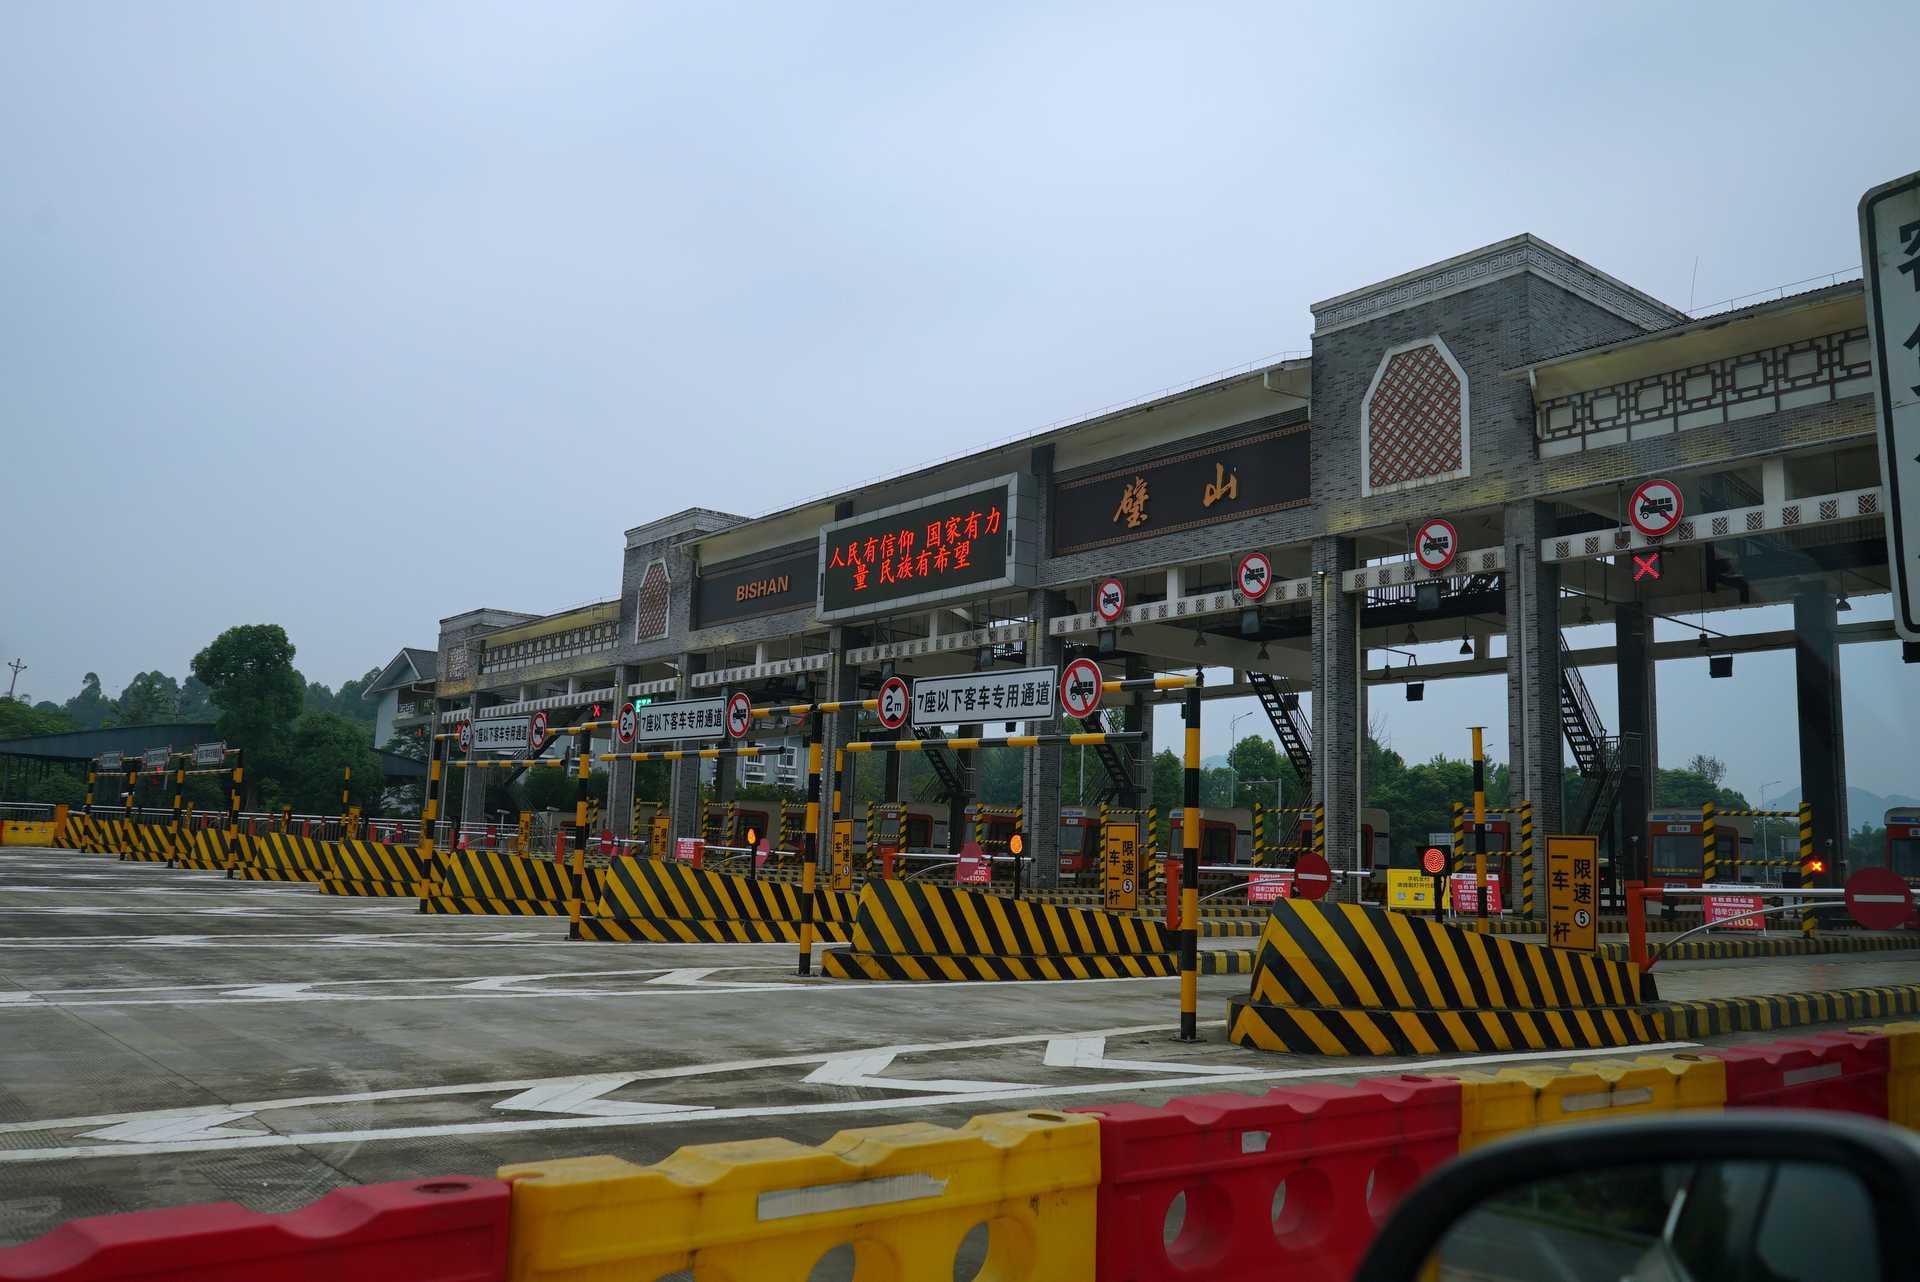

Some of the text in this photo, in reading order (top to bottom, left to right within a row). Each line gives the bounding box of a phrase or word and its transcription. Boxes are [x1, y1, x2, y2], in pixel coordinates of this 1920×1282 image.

[829, 506, 1001, 569] 人民有信仰 国家有力
[853, 540, 971, 591] 量 民族有希望
[736, 576, 789, 602] BISHAN
[885, 695, 902, 712] 2m
[917, 680, 1051, 714] 7座以下客车专用通道
[641, 709, 723, 732] 7座以下客车专用通道
[1109, 838, 1120, 905] 一车一杆
[1551, 855, 1570, 942] 一车一杆
